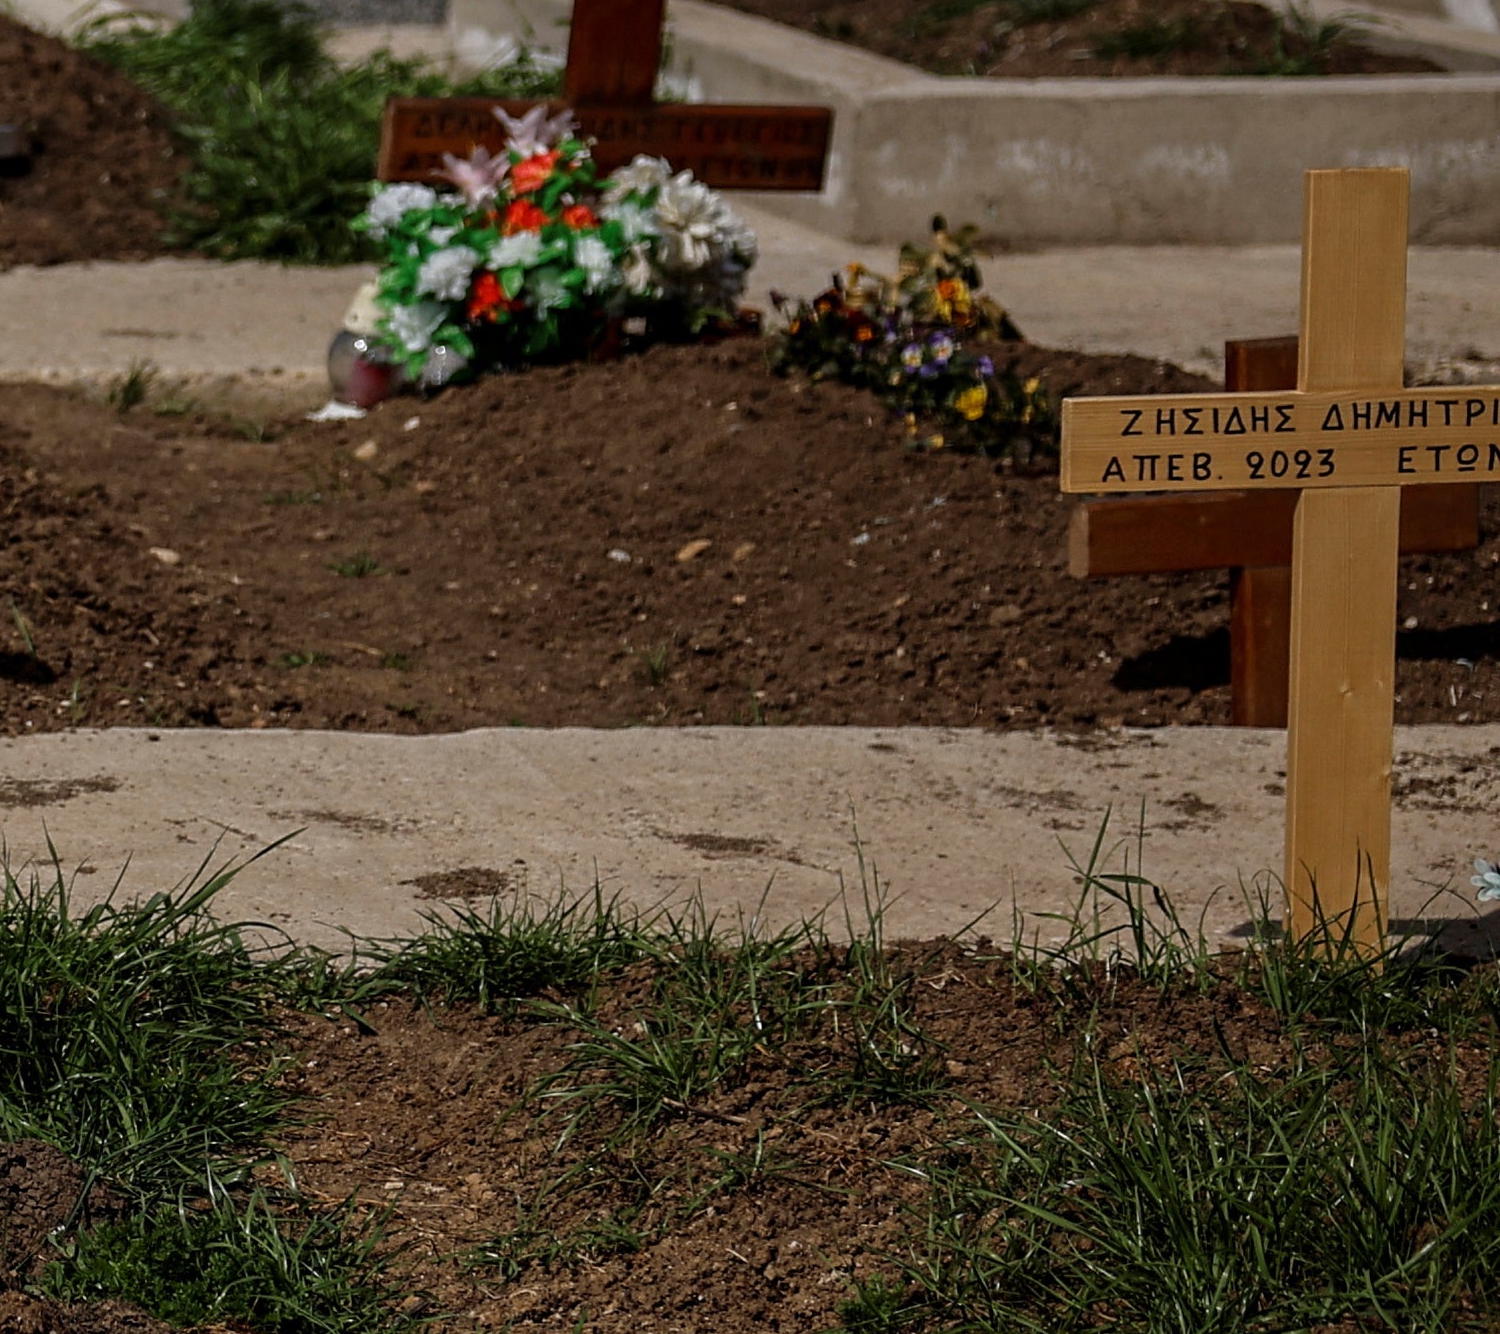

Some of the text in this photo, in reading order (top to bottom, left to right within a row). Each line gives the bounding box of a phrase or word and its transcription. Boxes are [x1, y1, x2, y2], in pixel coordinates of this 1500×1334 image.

[1120, 404, 1297, 437] ΖΗΣΙΔΗΣ
[1101, 452, 1223, 483] ΑΠΕΒ.
[1246, 448, 1336, 480] 2023
